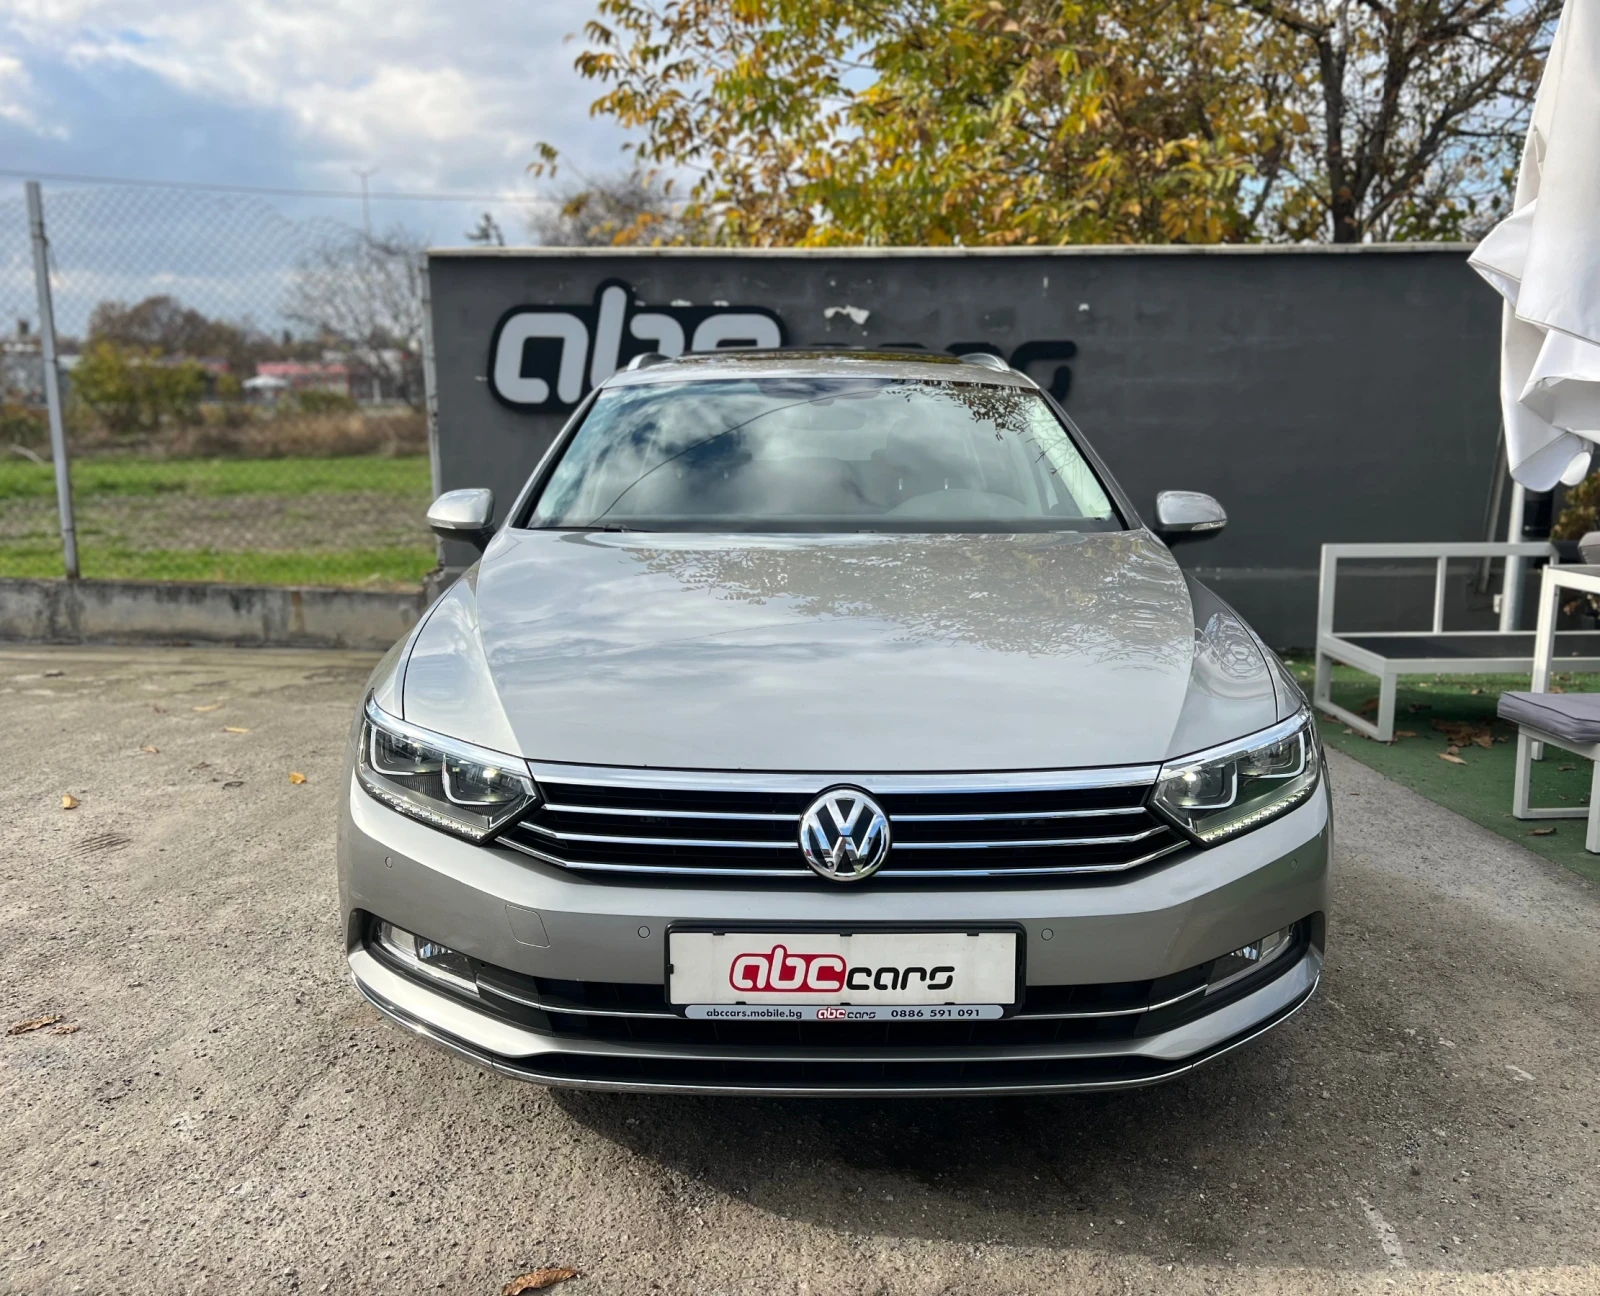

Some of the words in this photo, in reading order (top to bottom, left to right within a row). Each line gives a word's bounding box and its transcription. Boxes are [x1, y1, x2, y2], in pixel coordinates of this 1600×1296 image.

[706, 1008, 802, 1019] abccars.mobile.bg
[891, 1009, 924, 1018] 0886
[930, 1009, 952, 1018] 591
[958, 1009, 980, 1017] 091
